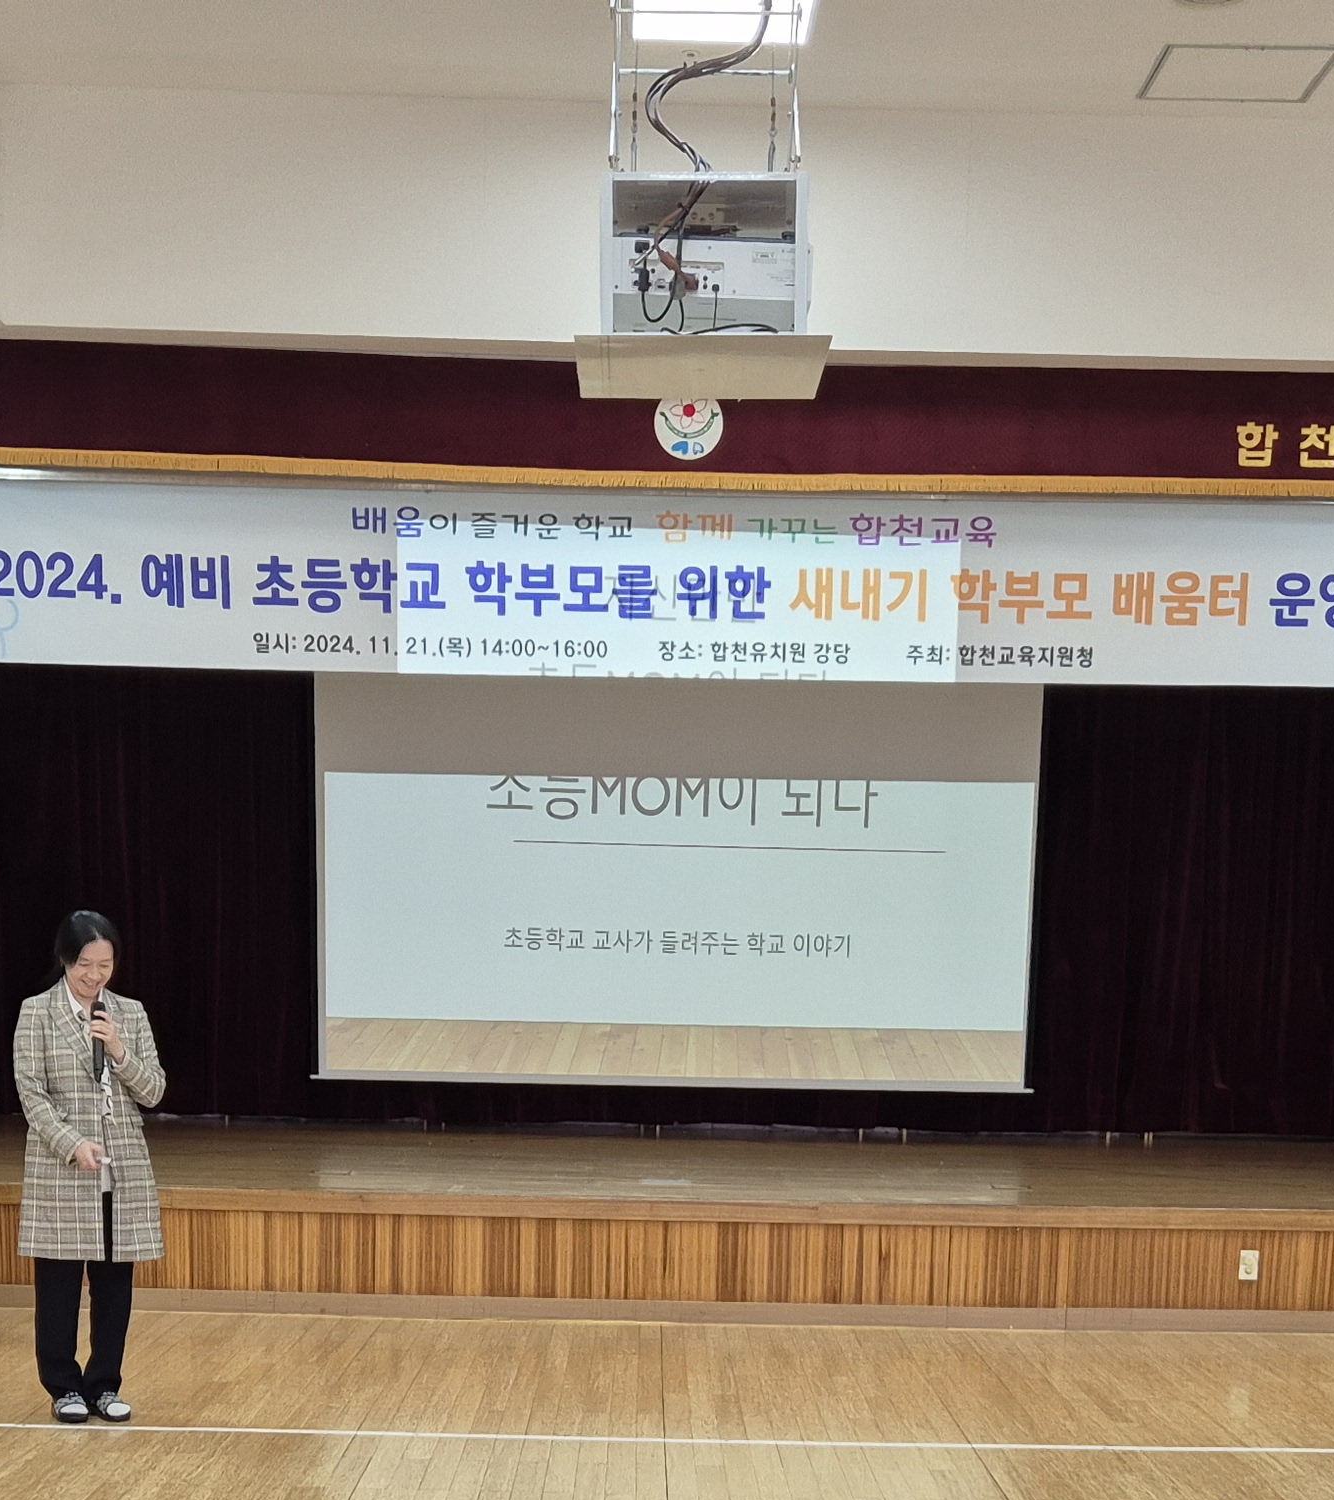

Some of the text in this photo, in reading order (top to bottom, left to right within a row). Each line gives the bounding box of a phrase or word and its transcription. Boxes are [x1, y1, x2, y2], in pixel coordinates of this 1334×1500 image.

[351, 505, 997, 548] 배움이 즐거운 학교 함께 가꾸는 합천교육
[141, 553, 231, 610] 예비
[252, 555, 446, 614] 초등학교
[465, 560, 658, 619] 학부모를
[676, 564, 772, 620] 위한
[789, 566, 929, 623] 새내기
[950, 568, 1093, 625] 학부모
[1112, 571, 1250, 627] 배움터
[252, 631, 298, 655] 일시:
[303, 635, 362, 656] 2024.
[480, 638, 609, 659] 14:00~16:00
[657, 640, 704, 662] 장소:
[710, 641, 807, 664] 합천유치원
[813, 643, 852, 665] 강당
[905, 645, 951, 666] 주최:
[957, 645, 1095, 668] 합천교육지원청
[503, 926, 852, 959] 초등학교 교사가 들려주는 학교 이야기
